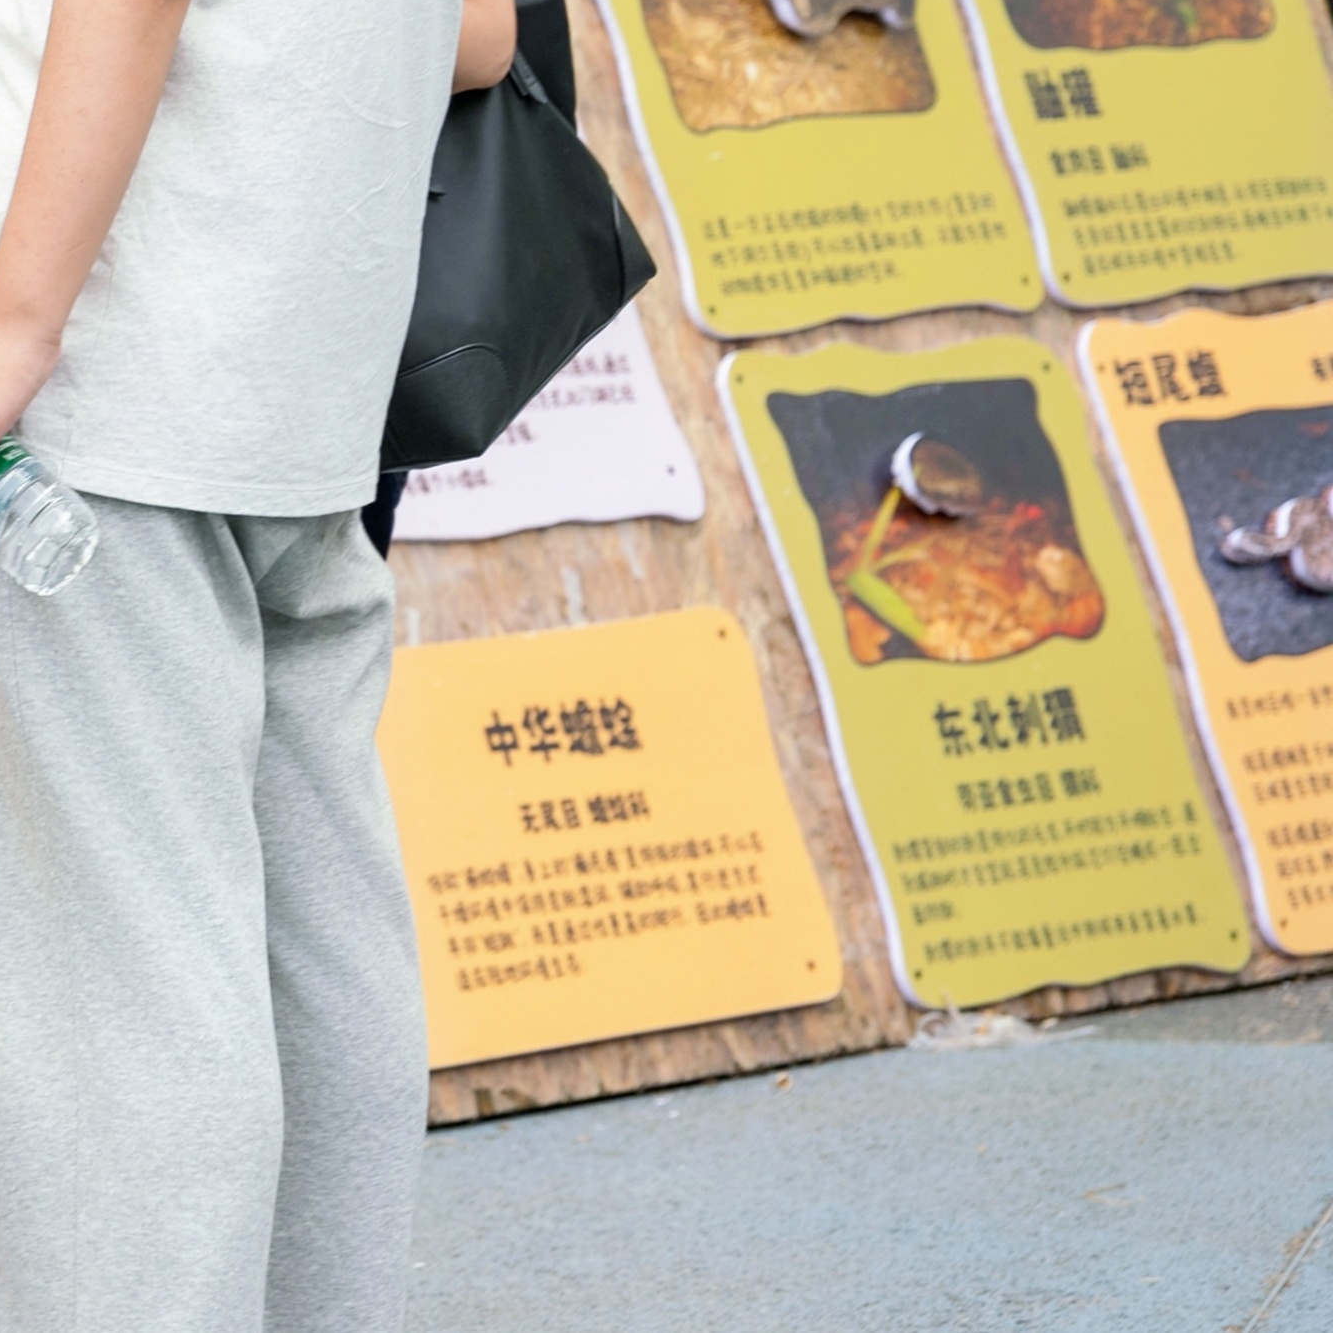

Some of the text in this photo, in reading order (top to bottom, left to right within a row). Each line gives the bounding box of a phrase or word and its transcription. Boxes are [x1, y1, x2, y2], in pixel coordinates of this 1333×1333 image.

[1115, 350, 1226, 405] 短尾蝮
[485, 696, 643, 768] 中华蟾蜍
[933, 685, 1086, 757] 东北刺猬
[520, 798, 581, 833] 无尾目
